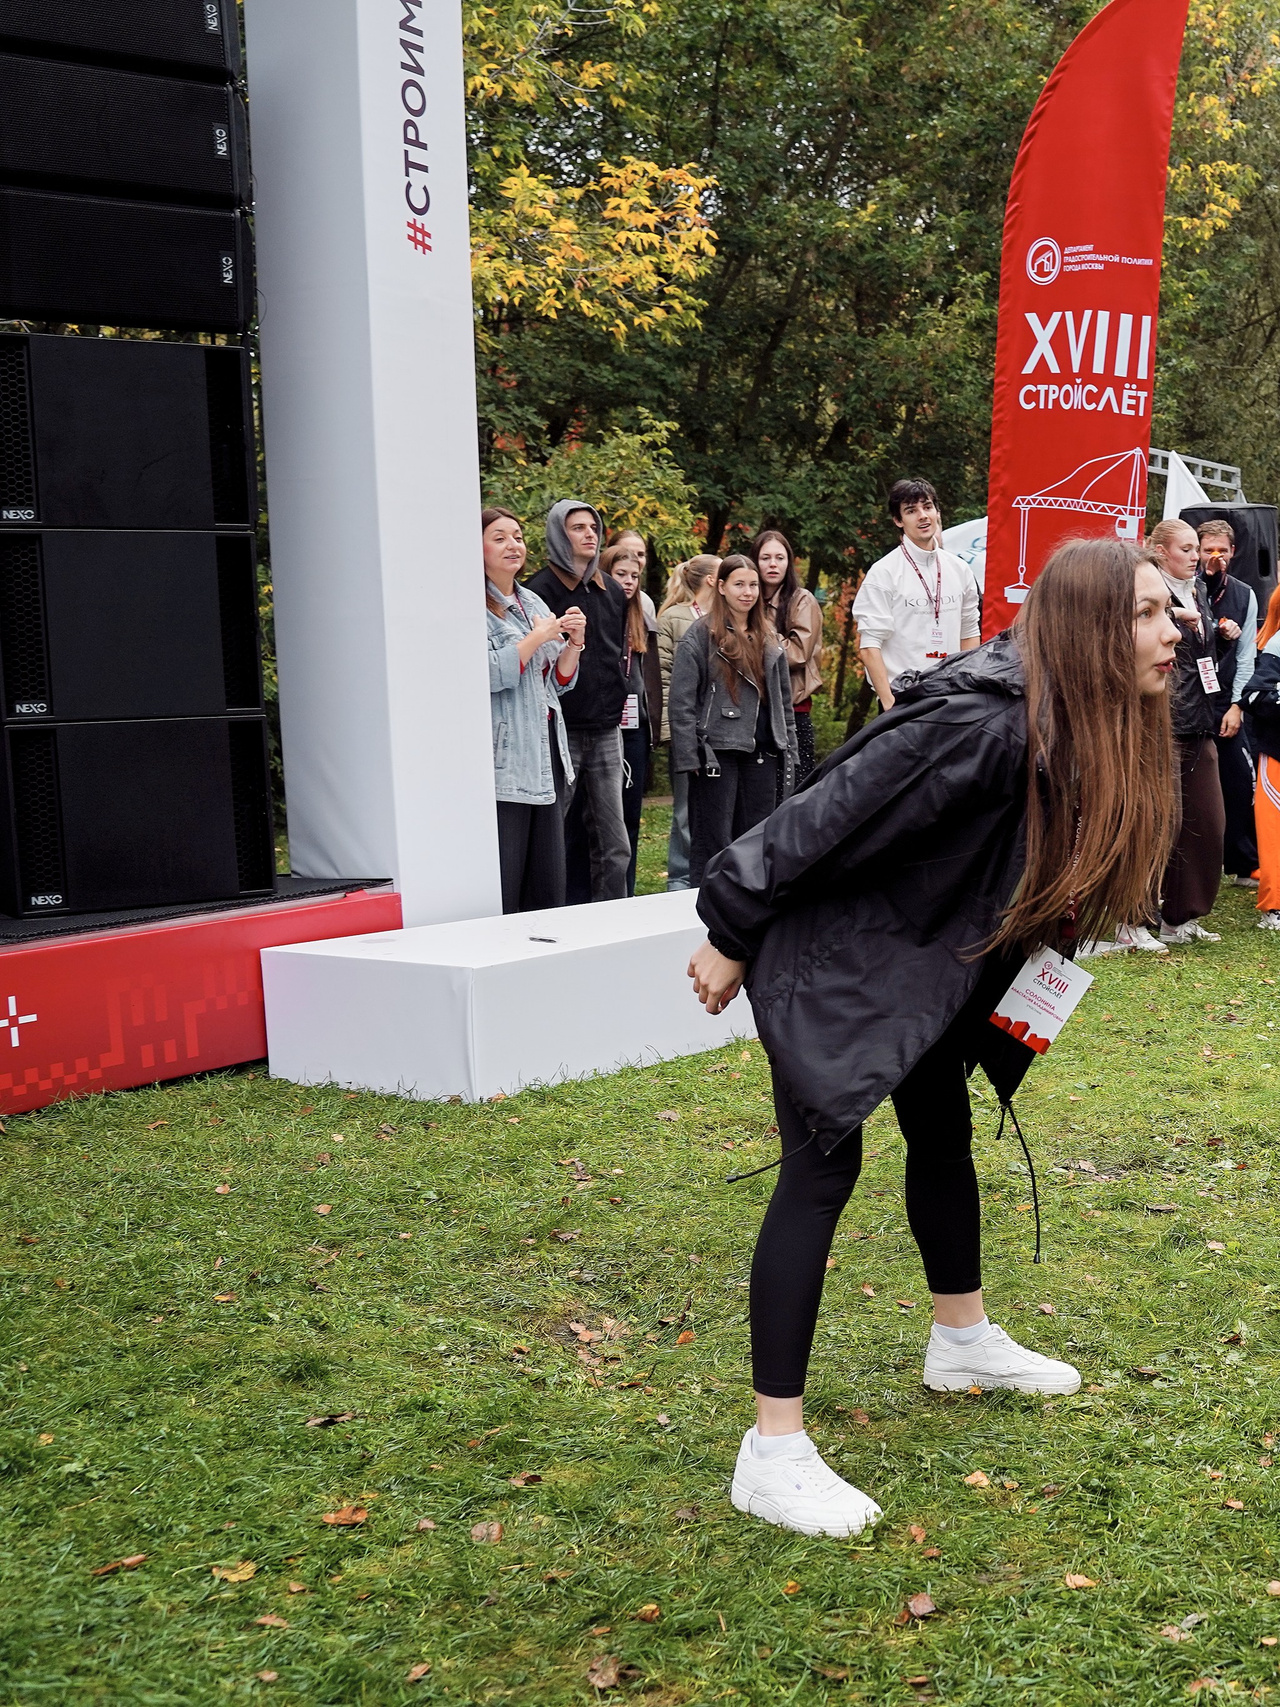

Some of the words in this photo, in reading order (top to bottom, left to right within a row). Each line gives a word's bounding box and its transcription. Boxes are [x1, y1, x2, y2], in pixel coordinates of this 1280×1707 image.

[206, 4, 219, 31] NEXO
[215, 128, 228, 156] NEXO
[222, 256, 233, 284] NEXO
[1020, 309, 1152, 380] XVIII
[1018, 378, 1148, 417] СТРОЙСЛЁТ
[2, 509, 35, 520] NEXO
[15, 703, 48, 714] NEXO
[31, 894, 63, 906] NEXO
[1036, 967, 1069, 994] XVIII
